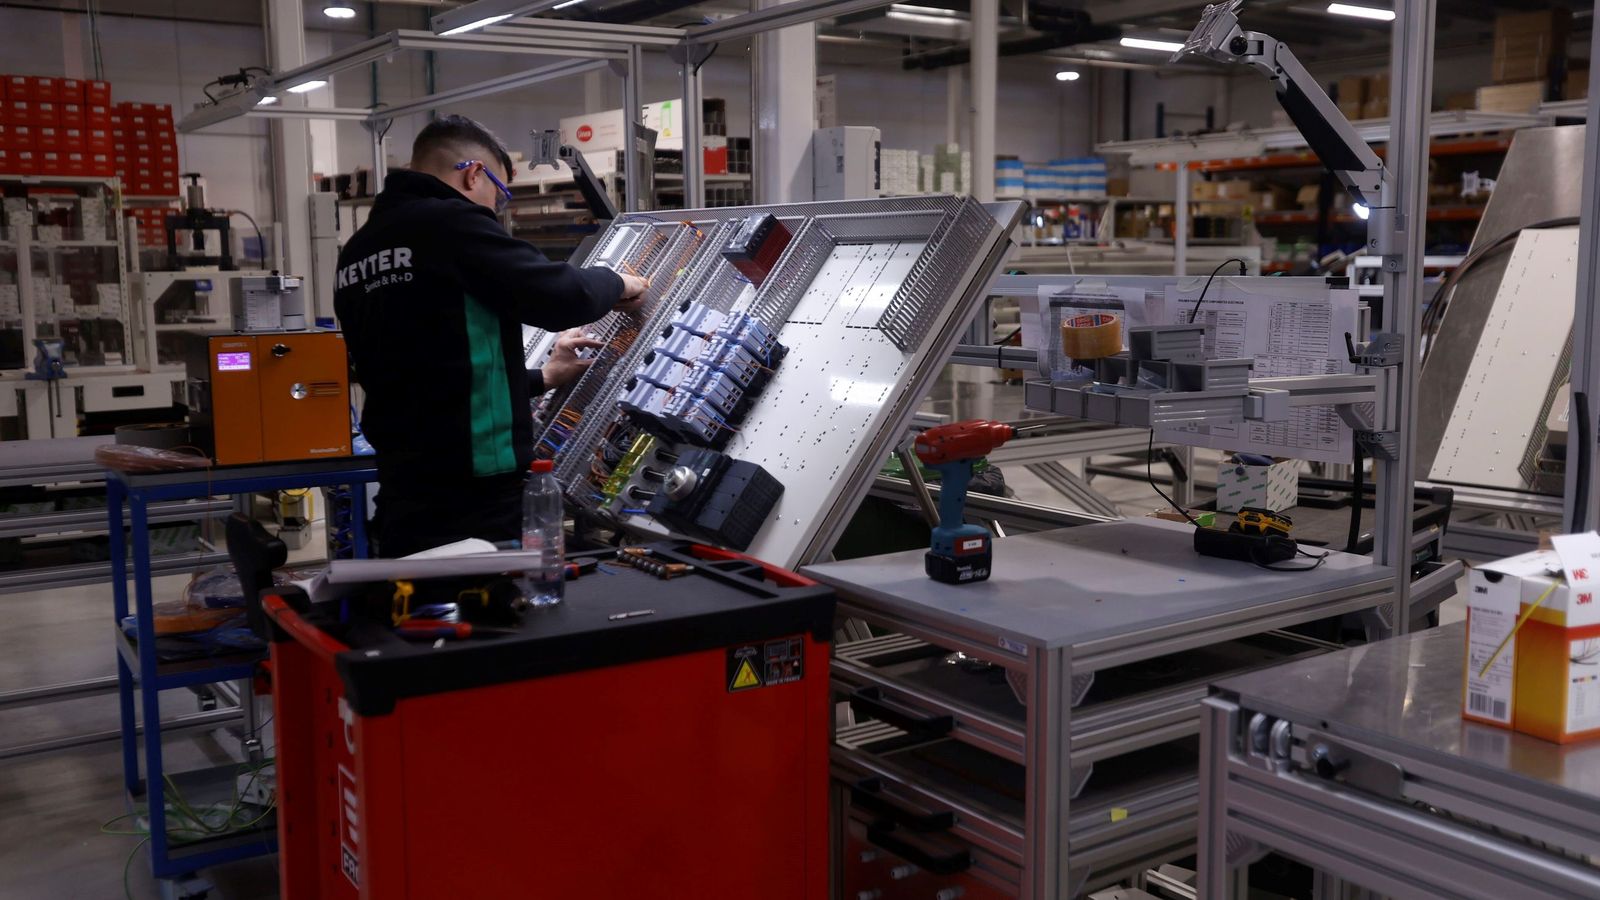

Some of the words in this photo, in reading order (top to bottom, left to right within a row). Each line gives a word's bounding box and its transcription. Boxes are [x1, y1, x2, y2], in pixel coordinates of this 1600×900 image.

[338, 247, 413, 289] KEYTER
[381, 276, 389, 285] &
[390, 272, 413, 283] R+D
[1576, 592, 1593, 605] 3M
